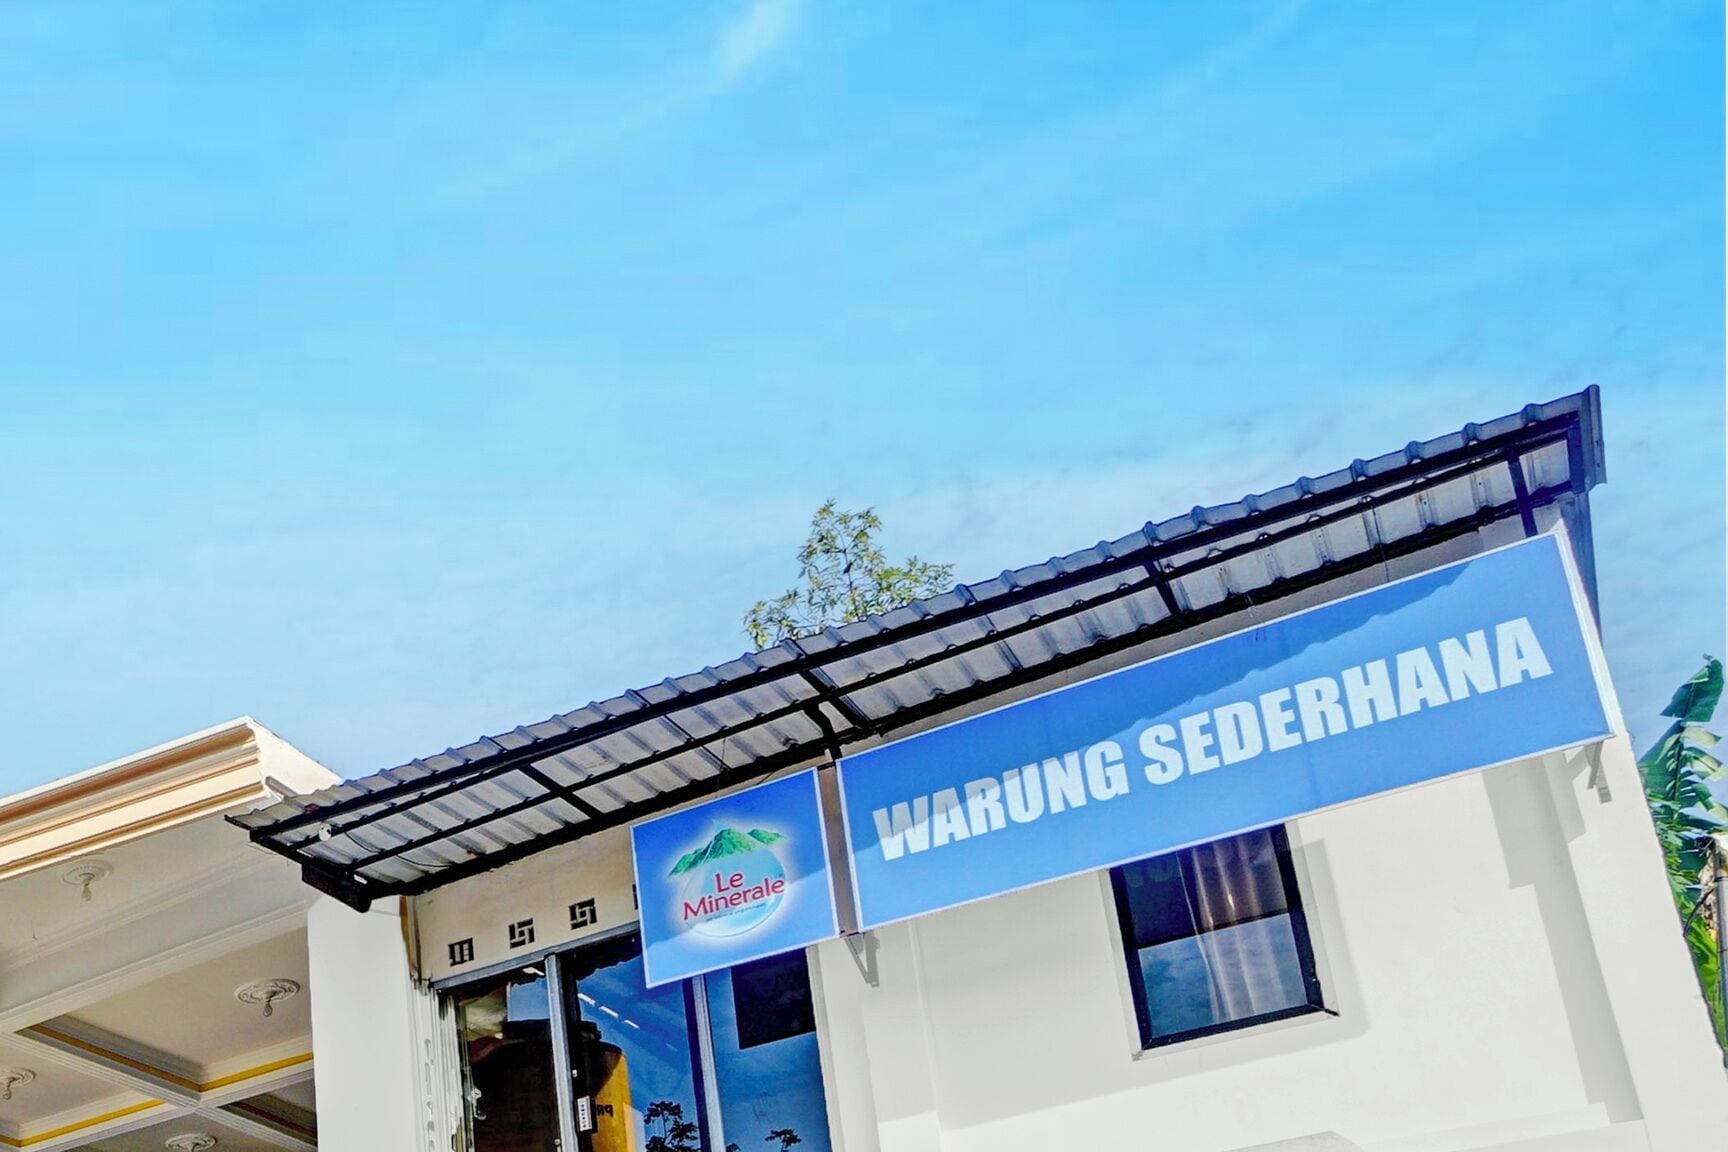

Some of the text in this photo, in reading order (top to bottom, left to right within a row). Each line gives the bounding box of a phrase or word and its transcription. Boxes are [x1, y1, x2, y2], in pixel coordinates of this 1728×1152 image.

[872, 617, 1553, 861] WARUNG SEDERHANA
[683, 878, 785, 920] Minerale
[714, 872, 744, 893] Le
